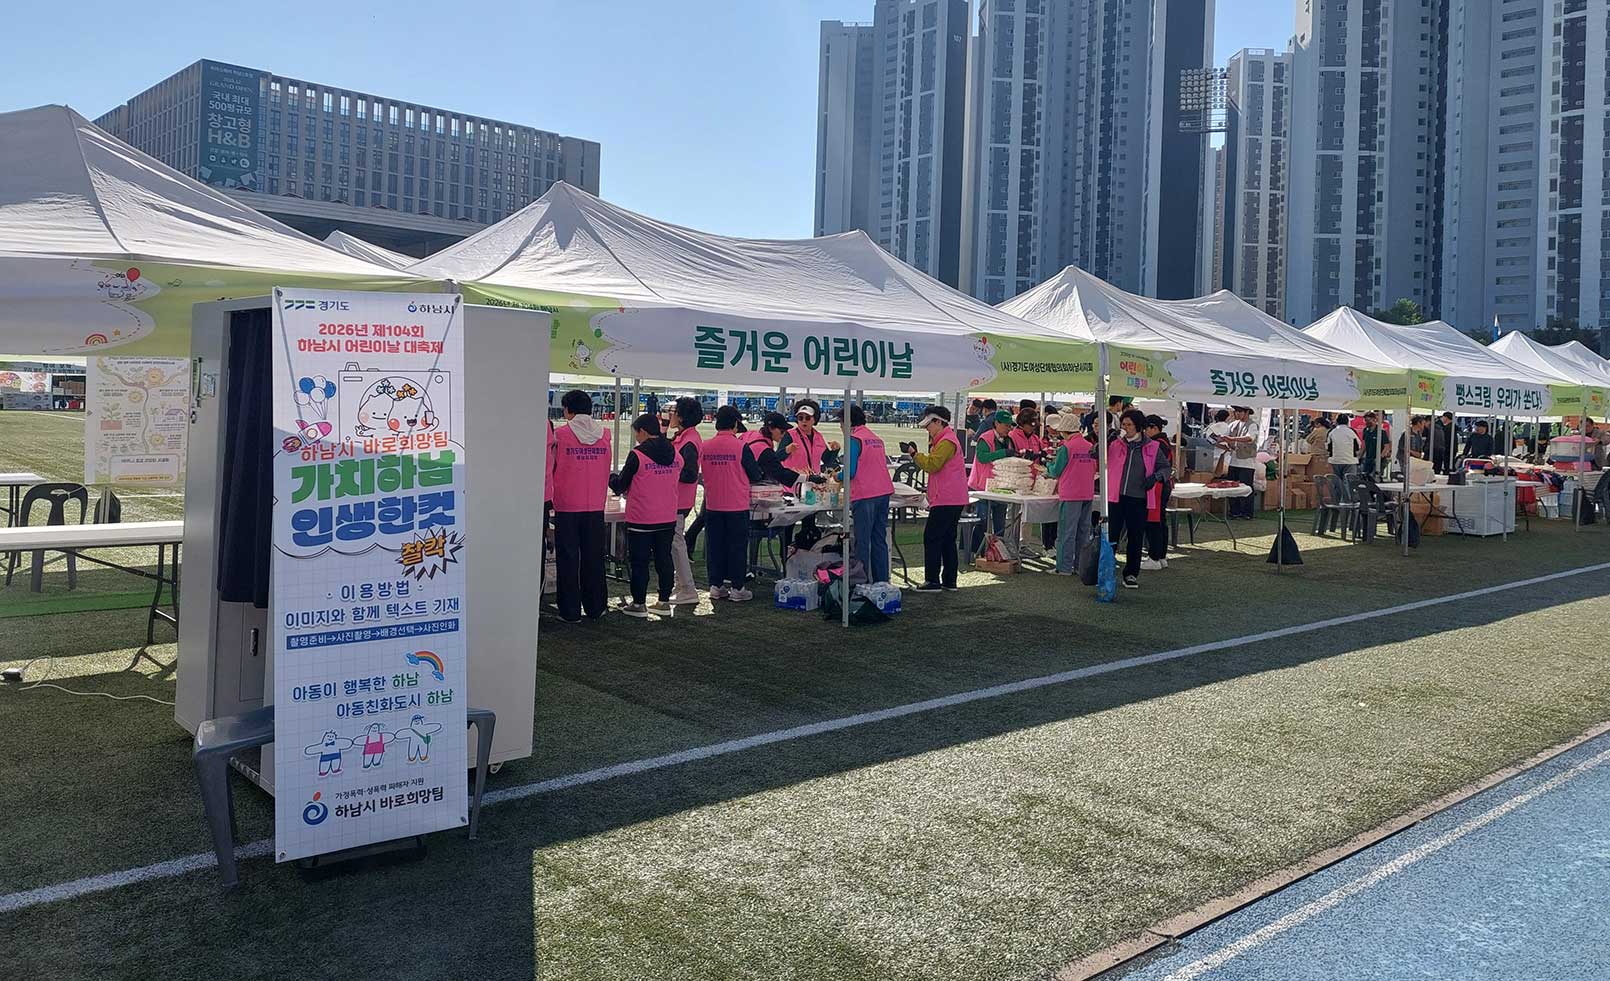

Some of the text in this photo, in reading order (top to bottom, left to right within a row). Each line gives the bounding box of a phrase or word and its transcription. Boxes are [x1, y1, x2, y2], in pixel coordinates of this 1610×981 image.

[207, 112, 251, 133] 창고형
[207, 128, 251, 149] H&B
[319, 300, 350, 311] 경기도
[419, 304, 455, 315] 하남시
[318, 323, 424, 338] 2026년 제104회
[297, 338, 444, 354] 하남시 어린이날 대축제
[693, 325, 915, 379] 즐거운 어린이날
[1209, 368, 1320, 400] 즐거운 어린이날
[1455, 383, 1494, 409] 뻥스크림,
[1496, 387, 1522, 409] 우리가
[1523, 391, 1543, 410] 쏜다!
[301, 431, 448, 462] 하남시 바로희망팀
[291, 449, 456, 504] 가치하남
[291, 490, 456, 547] 인생한컷
[401, 535, 447, 566] 찰칵
[340, 580, 410, 600] 이용방법
[285, 597, 460, 627] 이미지와 함께 텍스트 기재
[293, 671, 420, 701] 아동이 행복한 하남
[336, 688, 454, 718] 아동친화도시 하남
[388, 780, 410, 790] 피해자
[410, 777, 425, 786] 지원
[335, 786, 444, 818] 하남시 바로희망팀
